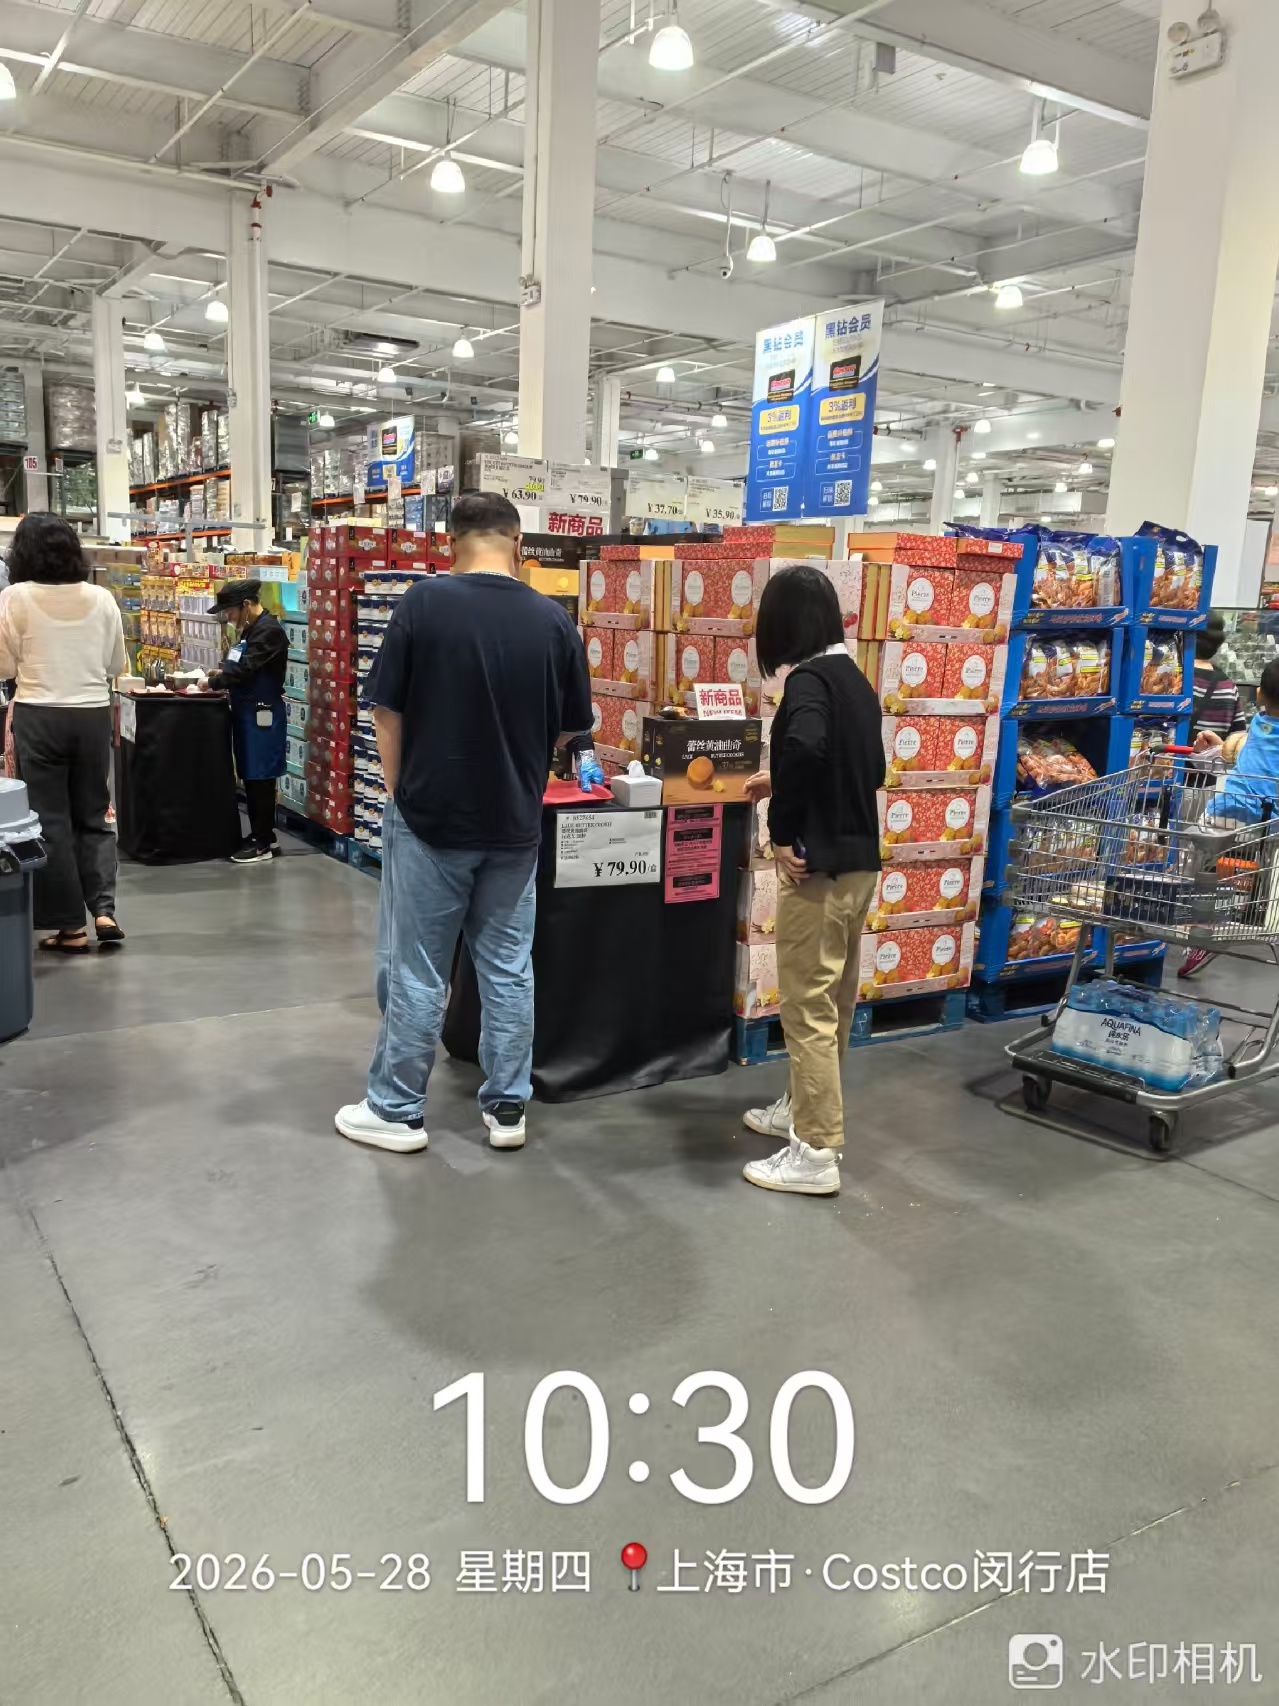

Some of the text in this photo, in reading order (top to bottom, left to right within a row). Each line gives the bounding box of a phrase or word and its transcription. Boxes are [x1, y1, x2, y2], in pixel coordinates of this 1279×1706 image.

[825, 313, 872, 339] 黑钻会员
[763, 330, 804, 354] 黑钻会员
[24, 457, 37, 469] 105
[548, 512, 604, 536] 新商品
[699, 688, 742, 707] 新商品
[891, 811, 909, 820] Pierre
[1100, 1017, 1141, 1037] AQUAFINA
